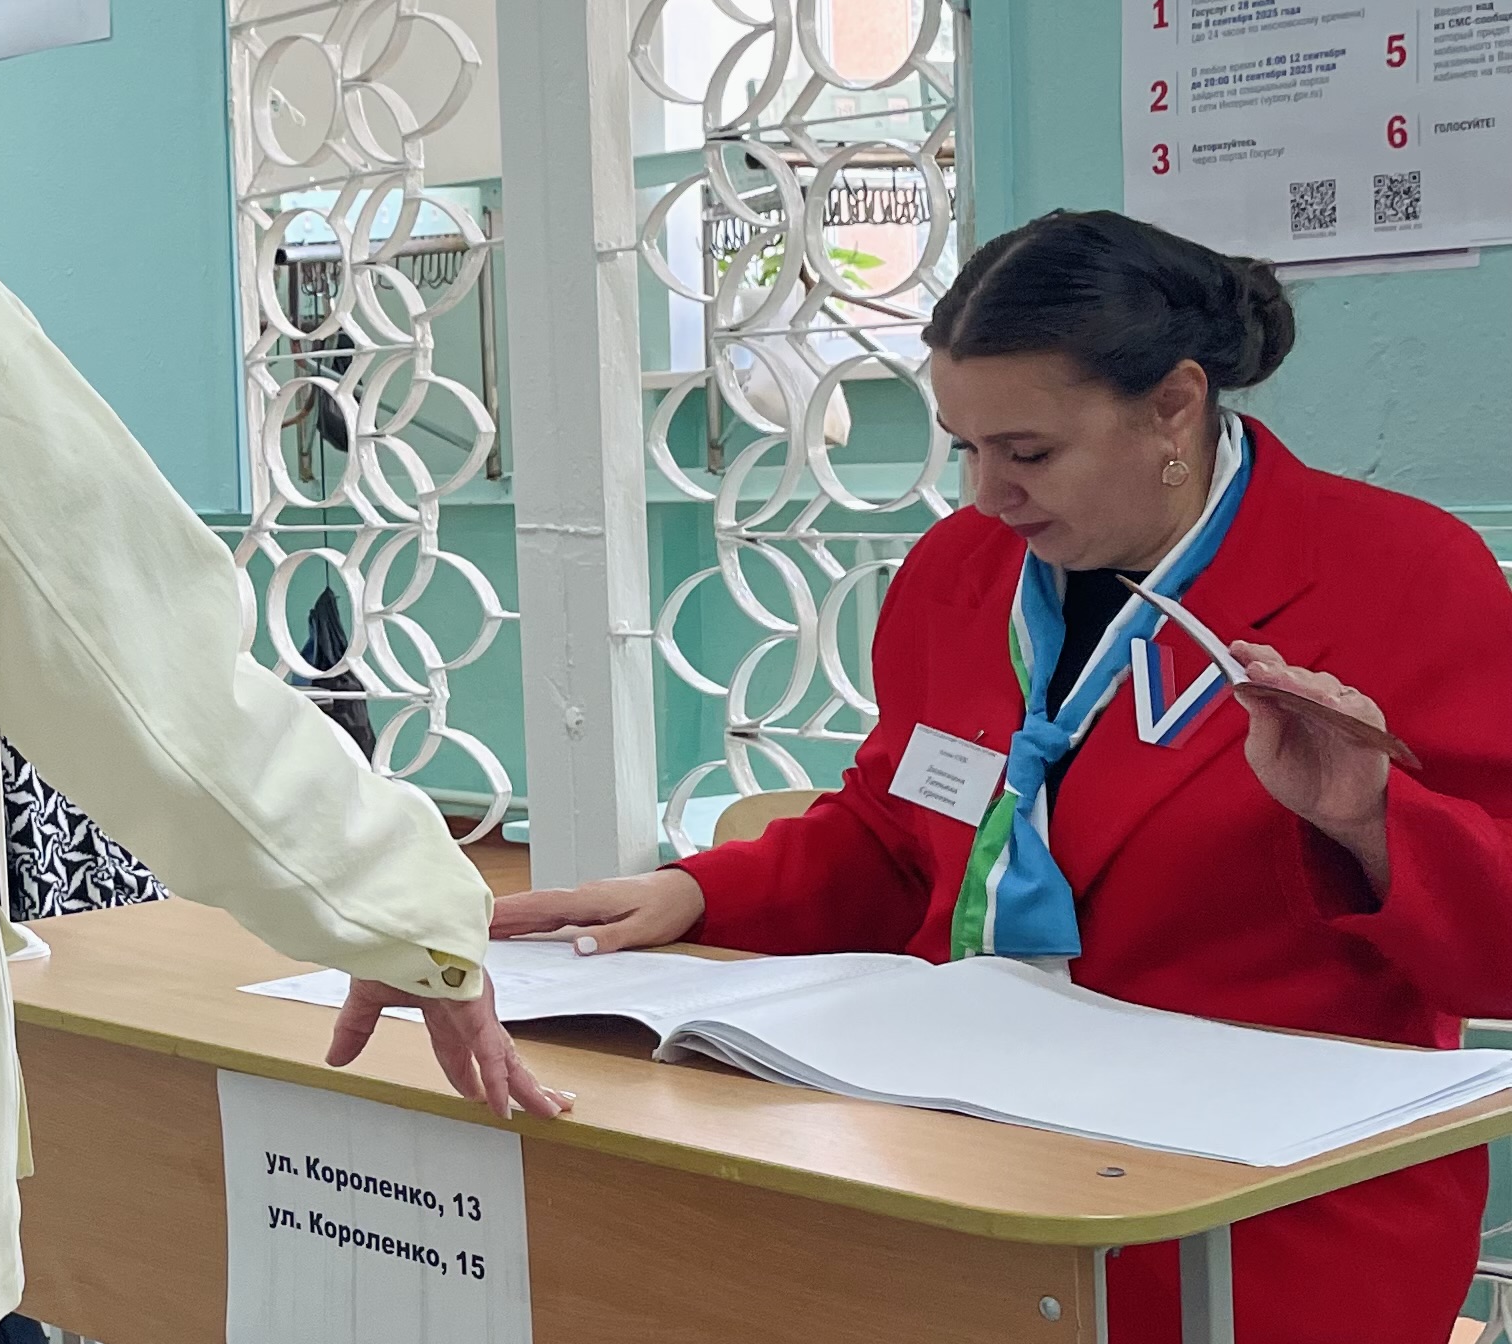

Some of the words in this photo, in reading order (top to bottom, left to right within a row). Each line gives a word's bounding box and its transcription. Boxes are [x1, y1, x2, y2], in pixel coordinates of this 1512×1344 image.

[1386, 34, 1407, 68] 5
[1150, 80, 1169, 112] 2
[1386, 114, 1408, 149] 6
[1152, 143, 1170, 175] 3
[265, 1151, 299, 1175] ул.
[305, 1155, 445, 1218] Короленко,
[452, 1193, 483, 1222] 13
[268, 1205, 302, 1230] ул.
[309, 1211, 448, 1276] Короленко,
[456, 1250, 485, 1280] 15
